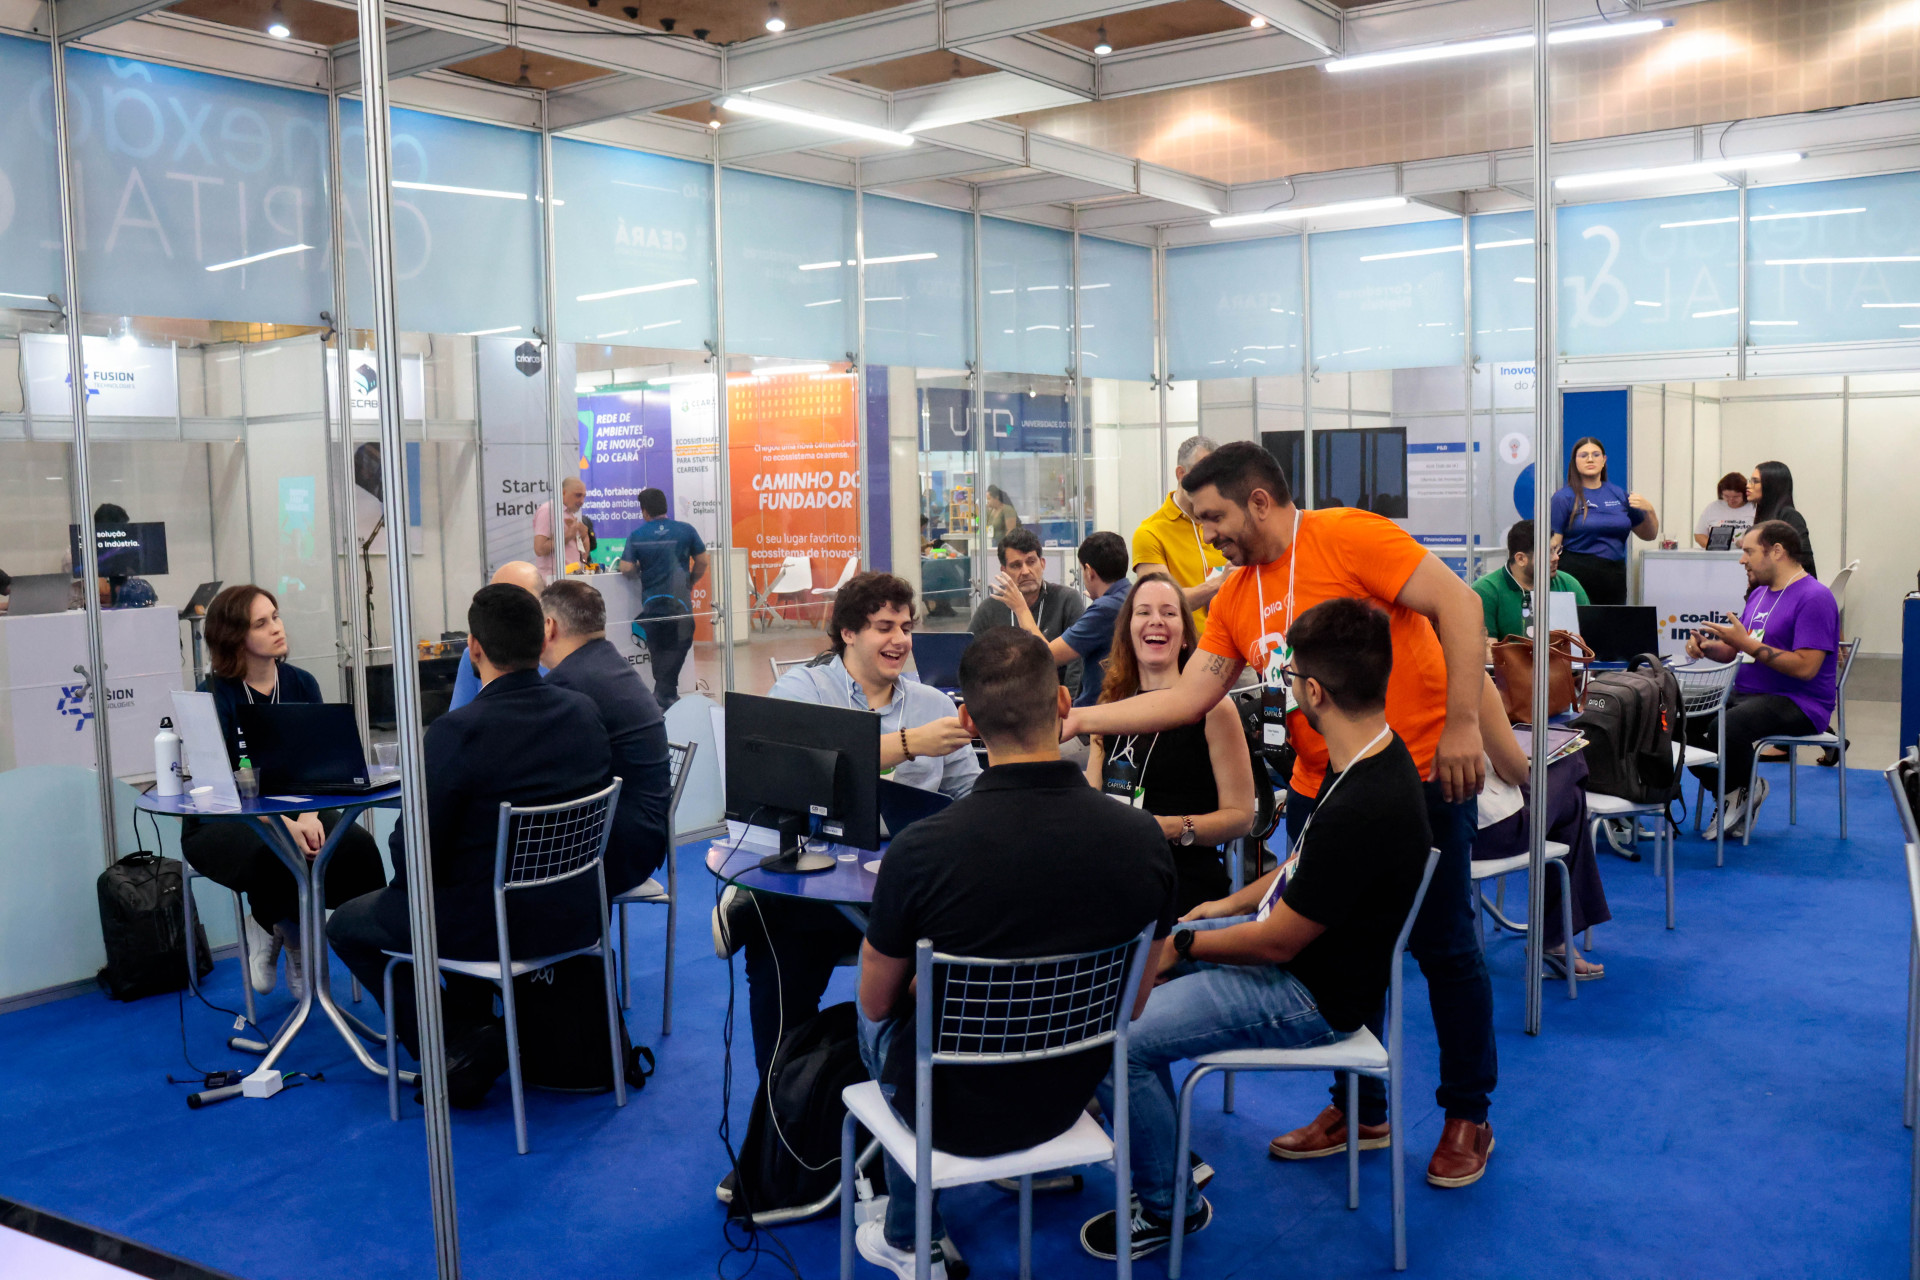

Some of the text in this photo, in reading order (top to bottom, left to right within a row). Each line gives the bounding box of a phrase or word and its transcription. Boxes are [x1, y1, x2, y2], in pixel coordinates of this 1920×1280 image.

[93, 371, 135, 382] FUSION
[1514, 381, 1529, 391] do
[596, 413, 632, 425] REDE DE
[596, 425, 644, 437] AMBIENTES
[596, 435, 654, 451] DE INOVAÇÃO
[596, 450, 639, 463] DO CEARÁ
[752, 470, 834, 491] CAMINHO
[759, 491, 853, 510] FUNDADOR
[496, 501, 540, 516] Hard
[611, 512, 621, 520] do
[97, 530, 127, 539] solução
[756, 533, 764, 544] O
[765, 535, 782, 544] seu
[783, 533, 808, 546] lugar
[810, 533, 847, 544] favorito
[105, 539, 140, 548] Indústria.
[806, 548, 822, 558] de
[89, 689, 134, 703] FSION
